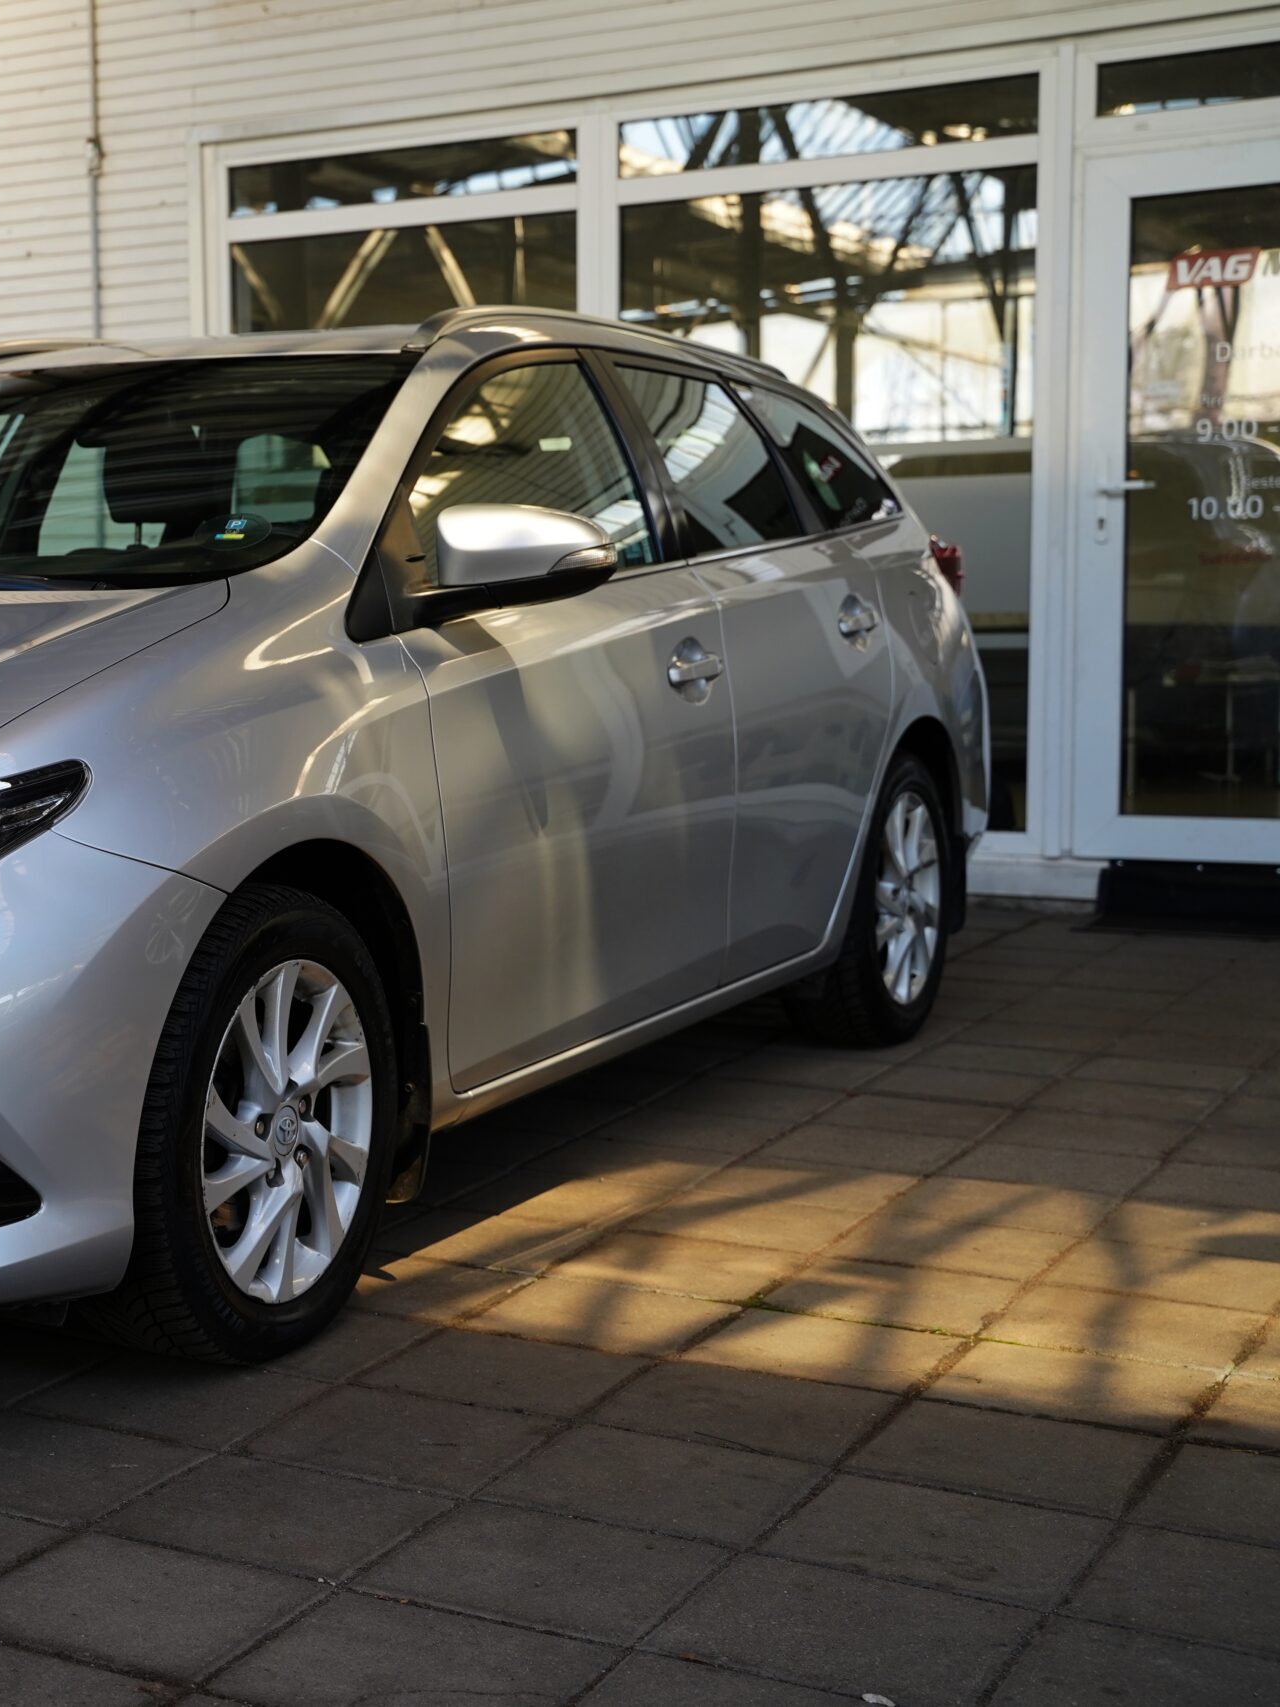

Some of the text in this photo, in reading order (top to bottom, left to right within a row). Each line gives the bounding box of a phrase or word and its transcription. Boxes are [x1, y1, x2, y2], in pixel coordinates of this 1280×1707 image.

[1176, 253, 1253, 286] VAG
[1196, 418, 1258, 443] 9.00
[1187, 495, 1264, 520] 10.00
